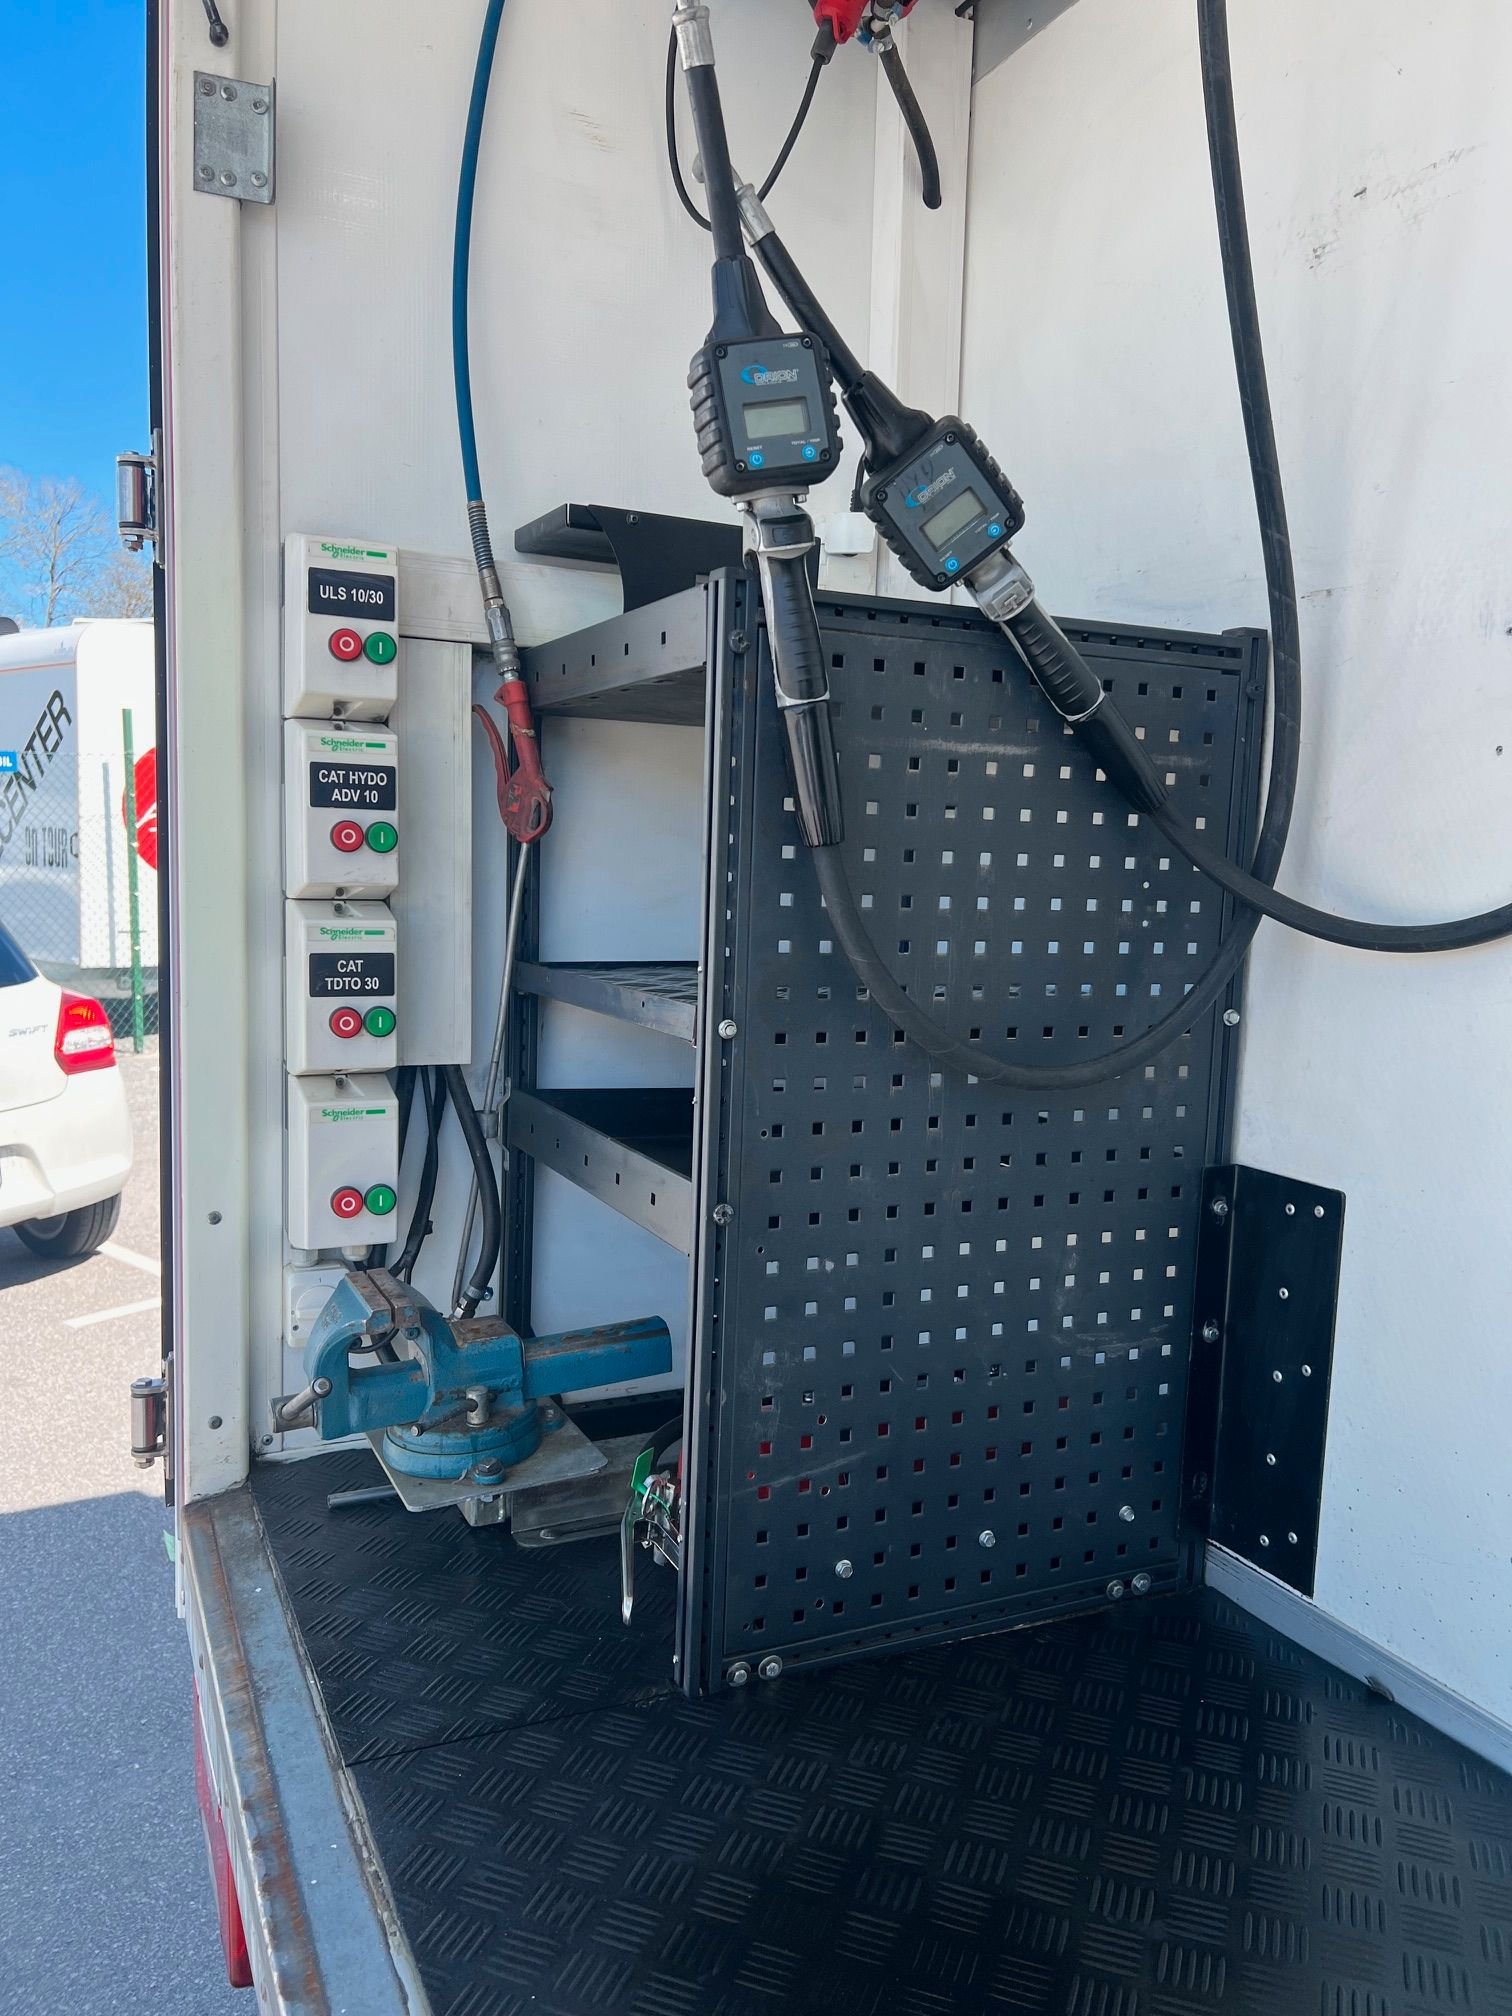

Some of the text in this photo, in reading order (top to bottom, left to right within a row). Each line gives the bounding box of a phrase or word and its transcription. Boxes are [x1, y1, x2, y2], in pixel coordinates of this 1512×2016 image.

[321, 543, 365, 558] Schneider
[320, 585, 384, 604] ULS 10/30
[320, 737, 364, 752] Schneider
[319, 770, 387, 785] CAT HYDO
[332, 789, 378, 803] ADV 10
[320, 927, 362, 940] Schneider
[337, 960, 364, 972] CAT
[325, 977, 379, 990] TDTO 30
[8, 1024, 48, 1037] SWIFT
[322, 1108, 364, 1121] Schneider
